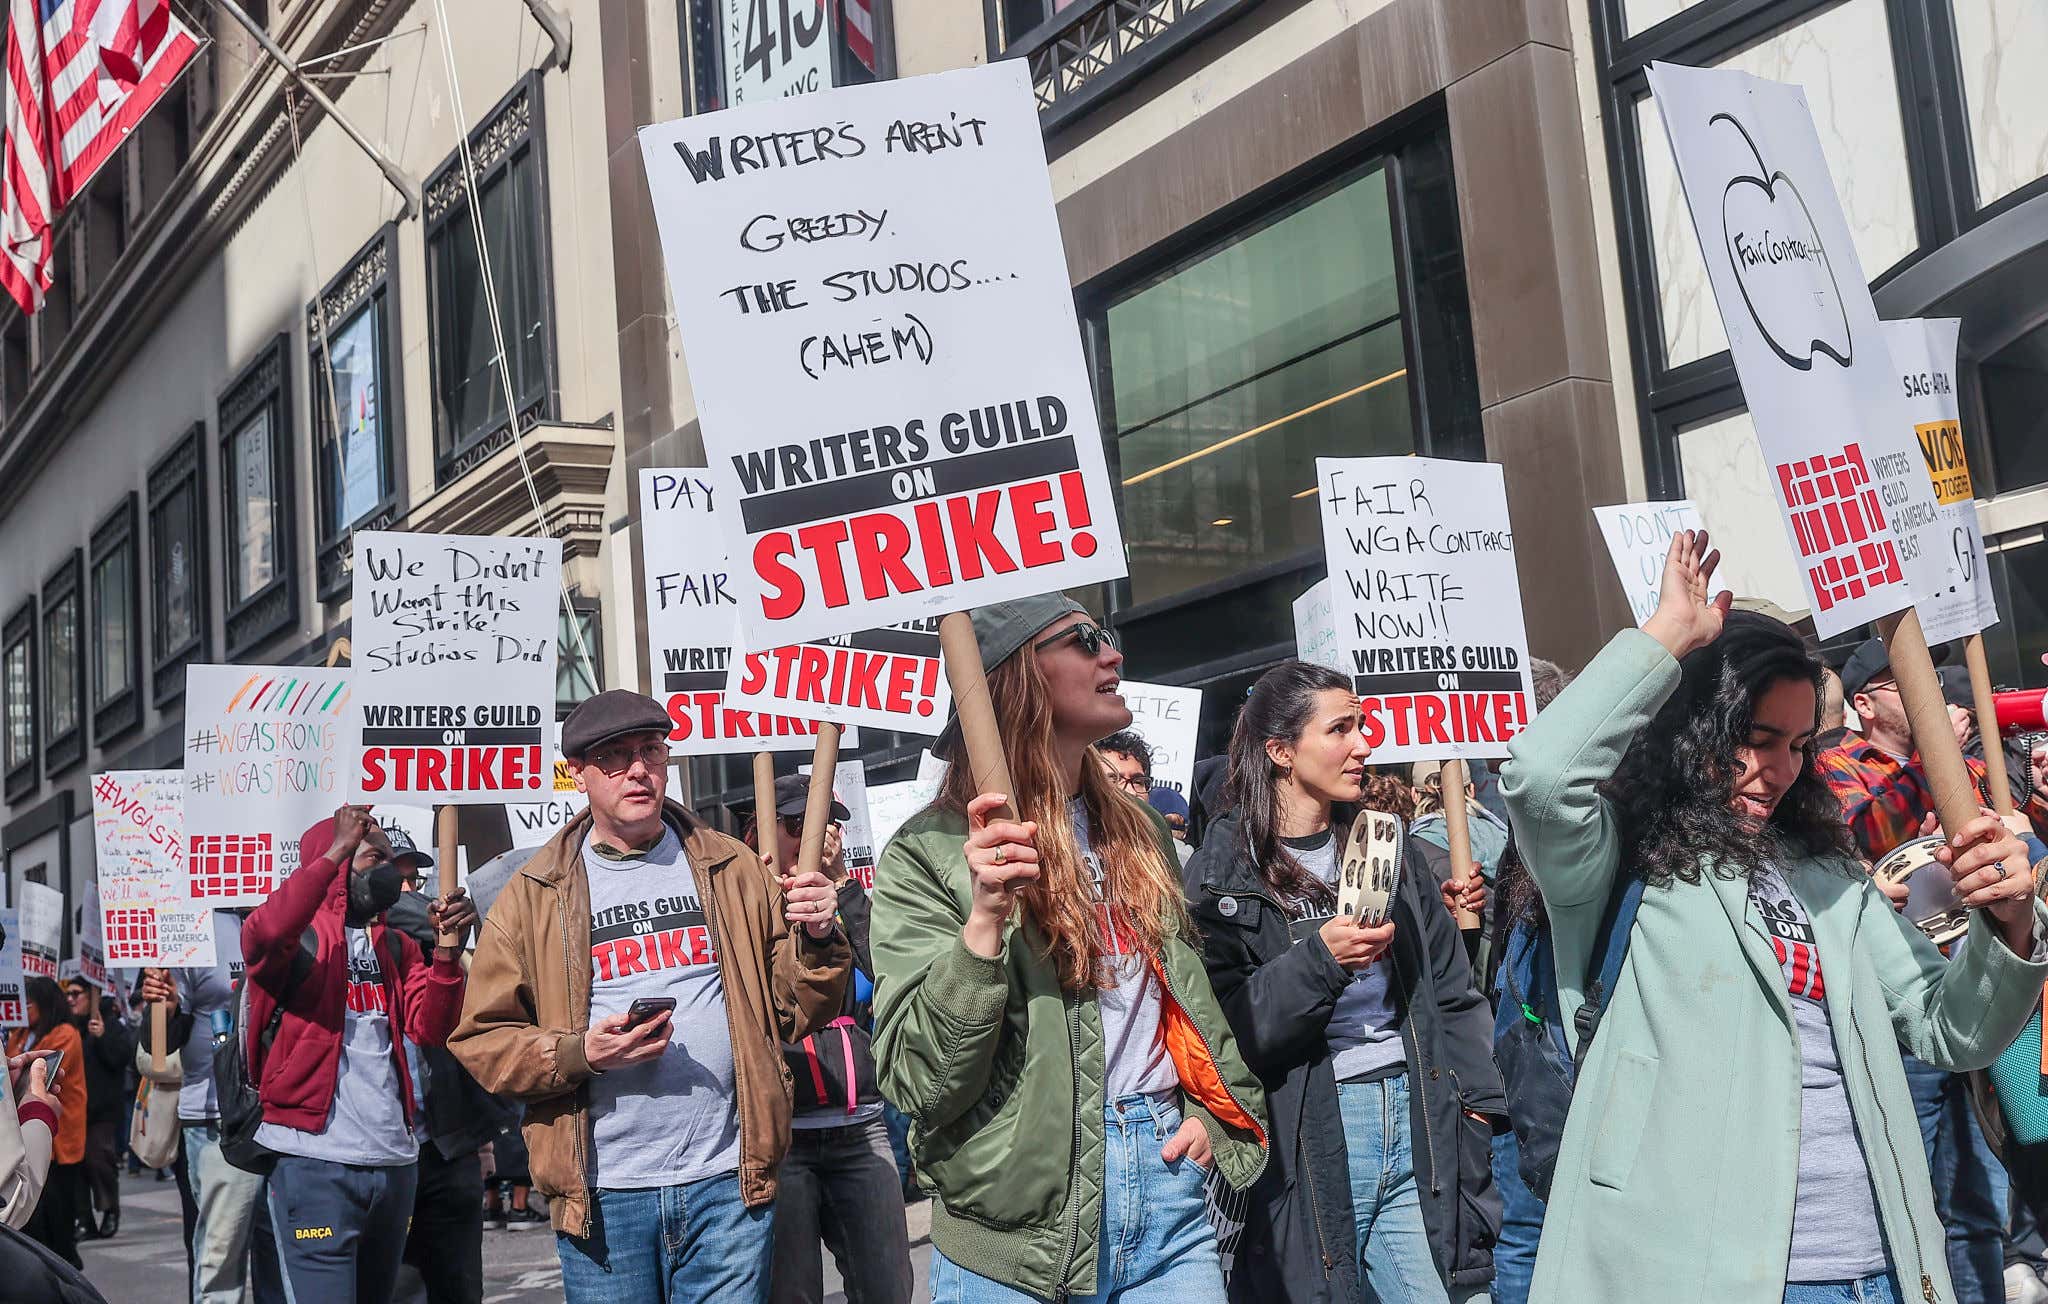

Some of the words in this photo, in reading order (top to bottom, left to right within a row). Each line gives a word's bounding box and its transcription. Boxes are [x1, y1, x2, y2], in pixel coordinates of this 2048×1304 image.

[673, 122, 866, 184] WRITERS
[885, 112, 986, 154] AREN'T
[740, 209, 896, 252] GREEDY.
[1734, 232, 1766, 272] Fair
[719, 280, 808, 313] THE
[800, 313, 933, 380] (AHEM)
[731, 419, 929, 495] WRITERS
[940, 395, 1068, 454] GUILD
[1871, 452, 1910, 480] WRITERS
[653, 474, 714, 512] PAY
[890, 466, 937, 500] ON
[1328, 471, 1434, 516] FAIR
[1882, 481, 1909, 507] GUILD
[1892, 513, 1900, 534] of
[1902, 501, 1938, 530] AMERICA
[752, 471, 1098, 620] STRIKE!
[1899, 535, 1921, 561] EAST
[367, 548, 424, 581] We
[445, 547, 547, 582] Didn't
[371, 584, 448, 618] Want
[456, 583, 521, 612] this
[656, 572, 737, 610] FAIR
[1345, 568, 1464, 602] WRITE
[392, 609, 500, 638] Strike!
[1355, 603, 1449, 642] NOW!!
[367, 640, 479, 672] Studios
[492, 634, 547, 664] Did
[664, 647, 732, 671] WRIT
[1352, 646, 1457, 673] WRITERS
[1462, 646, 1518, 670] GUILD
[740, 646, 940, 718] STRIKE!
[1437, 673, 1459, 690] ON
[363, 705, 466, 726] WRITERS
[474, 705, 541, 726] GUILD
[1362, 692, 1529, 748] STRIKE!
[442, 730, 465, 745] ON
[361, 746, 542, 792] STRIKE!
[160, 914, 195, 923] WRITERS
[655, 895, 701, 915] GUIL
[160, 924, 185, 932] GUILD
[161, 933, 169, 942] of
[171, 933, 209, 942] AMERICA
[633, 920, 653, 934] ON
[1776, 921, 1806, 940] ON
[161, 944, 183, 952] EAST
[591, 927, 717, 982] TRIKE
[295, 1227, 333, 1240] BARÇA
